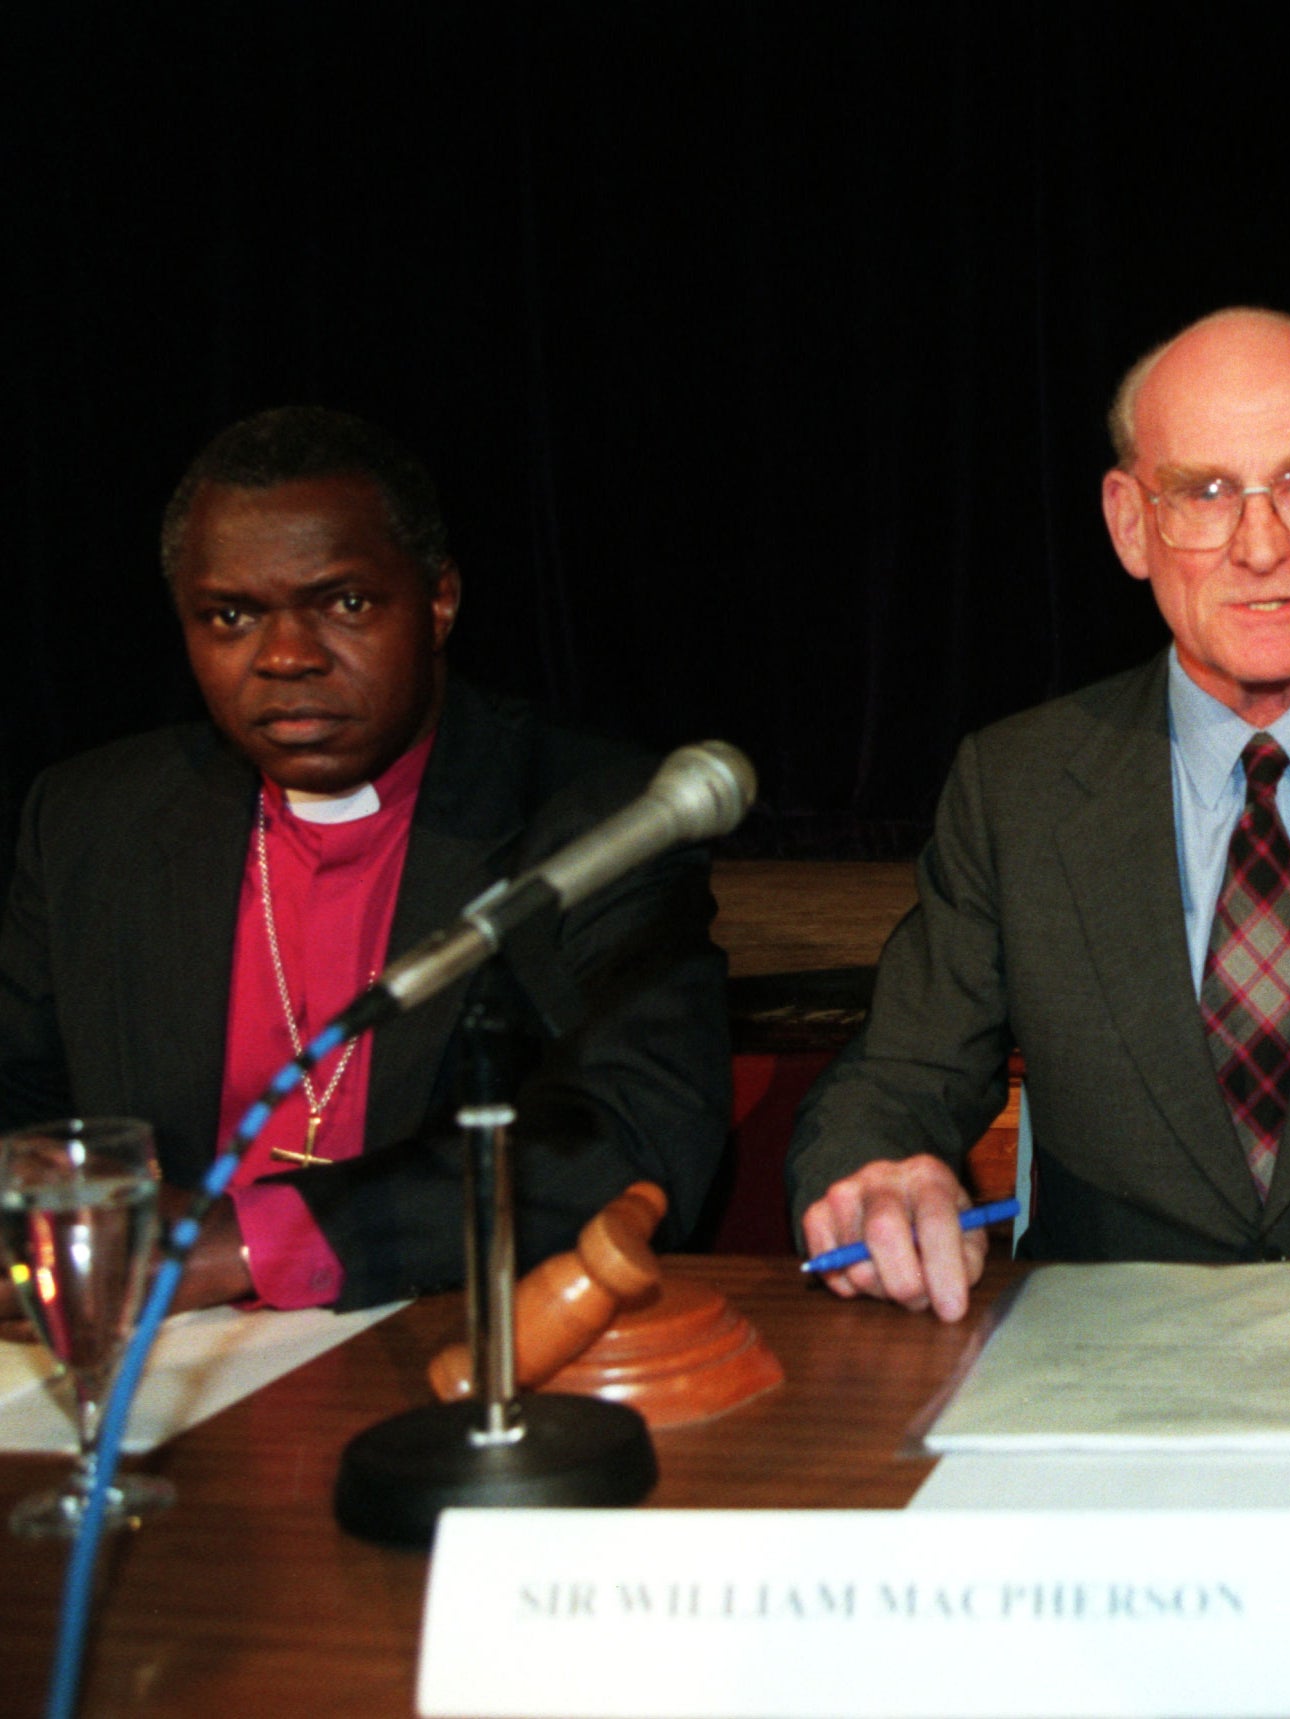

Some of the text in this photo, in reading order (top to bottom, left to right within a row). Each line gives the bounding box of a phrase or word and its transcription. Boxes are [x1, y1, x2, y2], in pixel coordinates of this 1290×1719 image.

[516, 1579, 1246, 1622] SIR WILLIAM MACPHERSON
